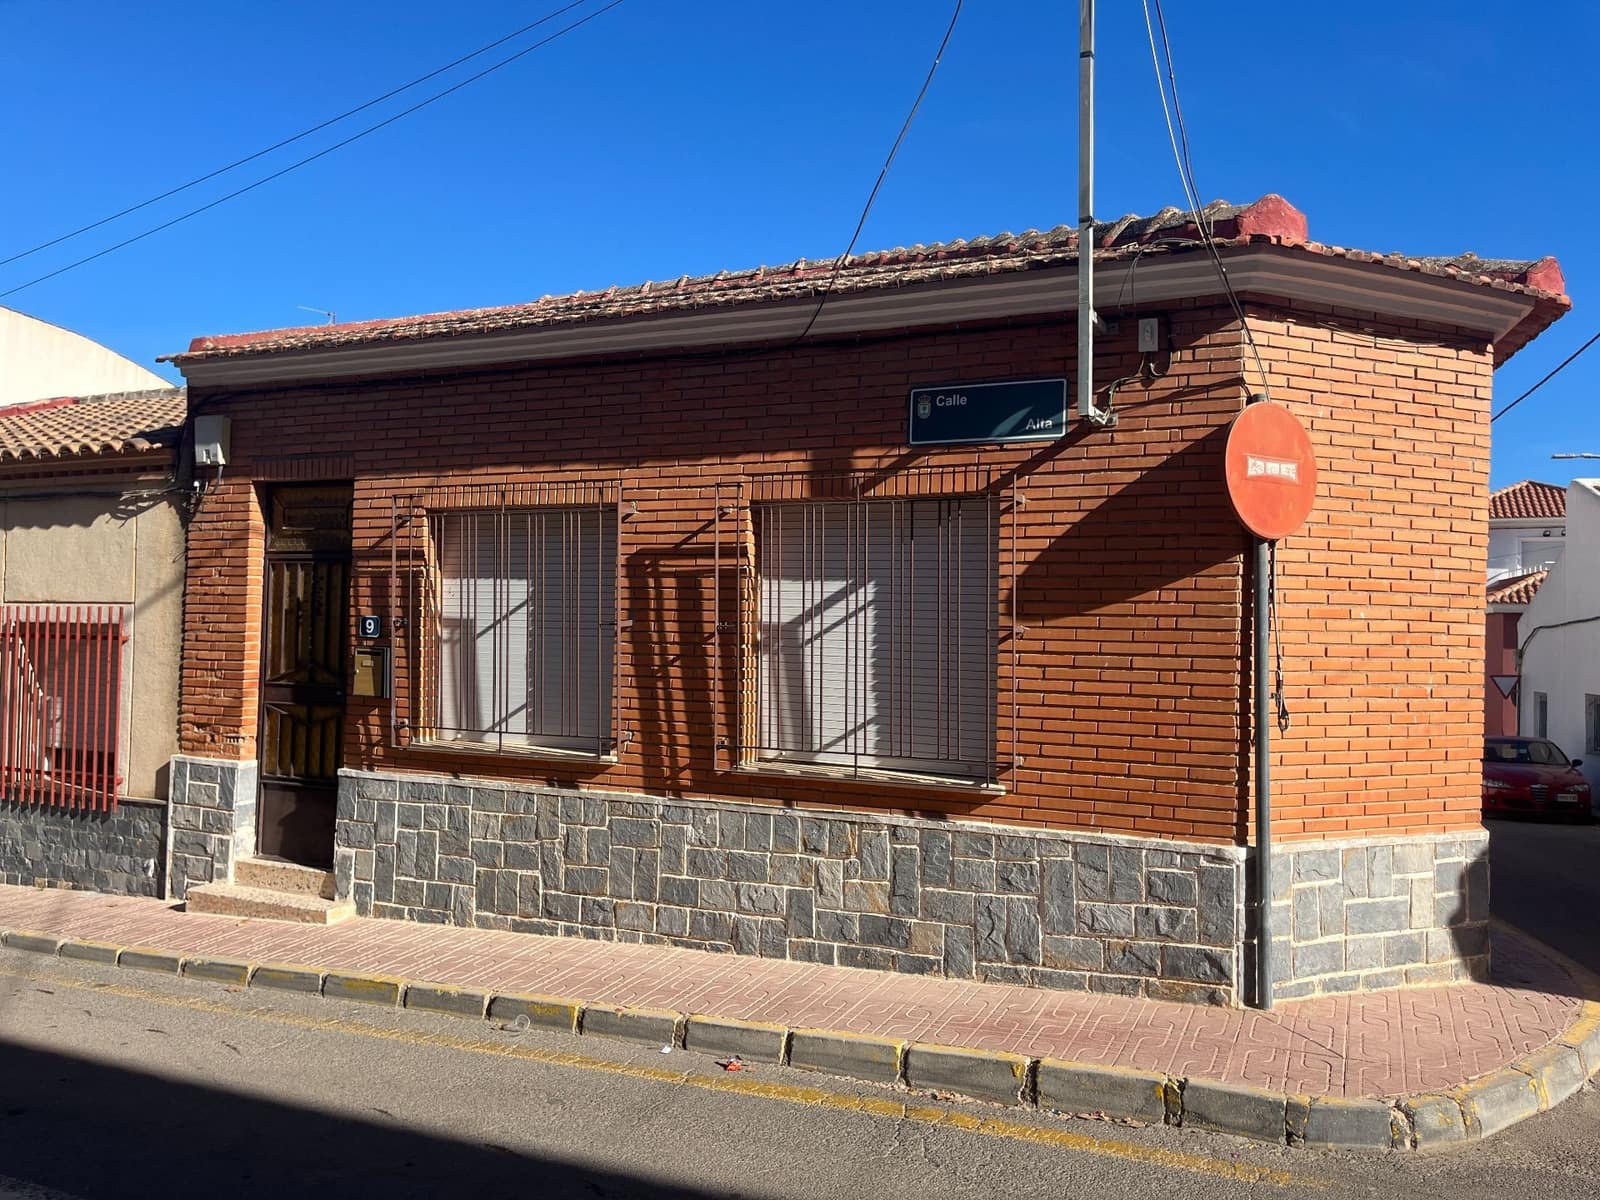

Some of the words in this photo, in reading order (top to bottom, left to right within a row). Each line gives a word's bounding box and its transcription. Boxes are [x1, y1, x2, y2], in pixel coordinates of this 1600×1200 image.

[936, 395, 967, 407] Calle
[1025, 418, 1053, 430] Alta
[365, 619, 375, 634] 9
